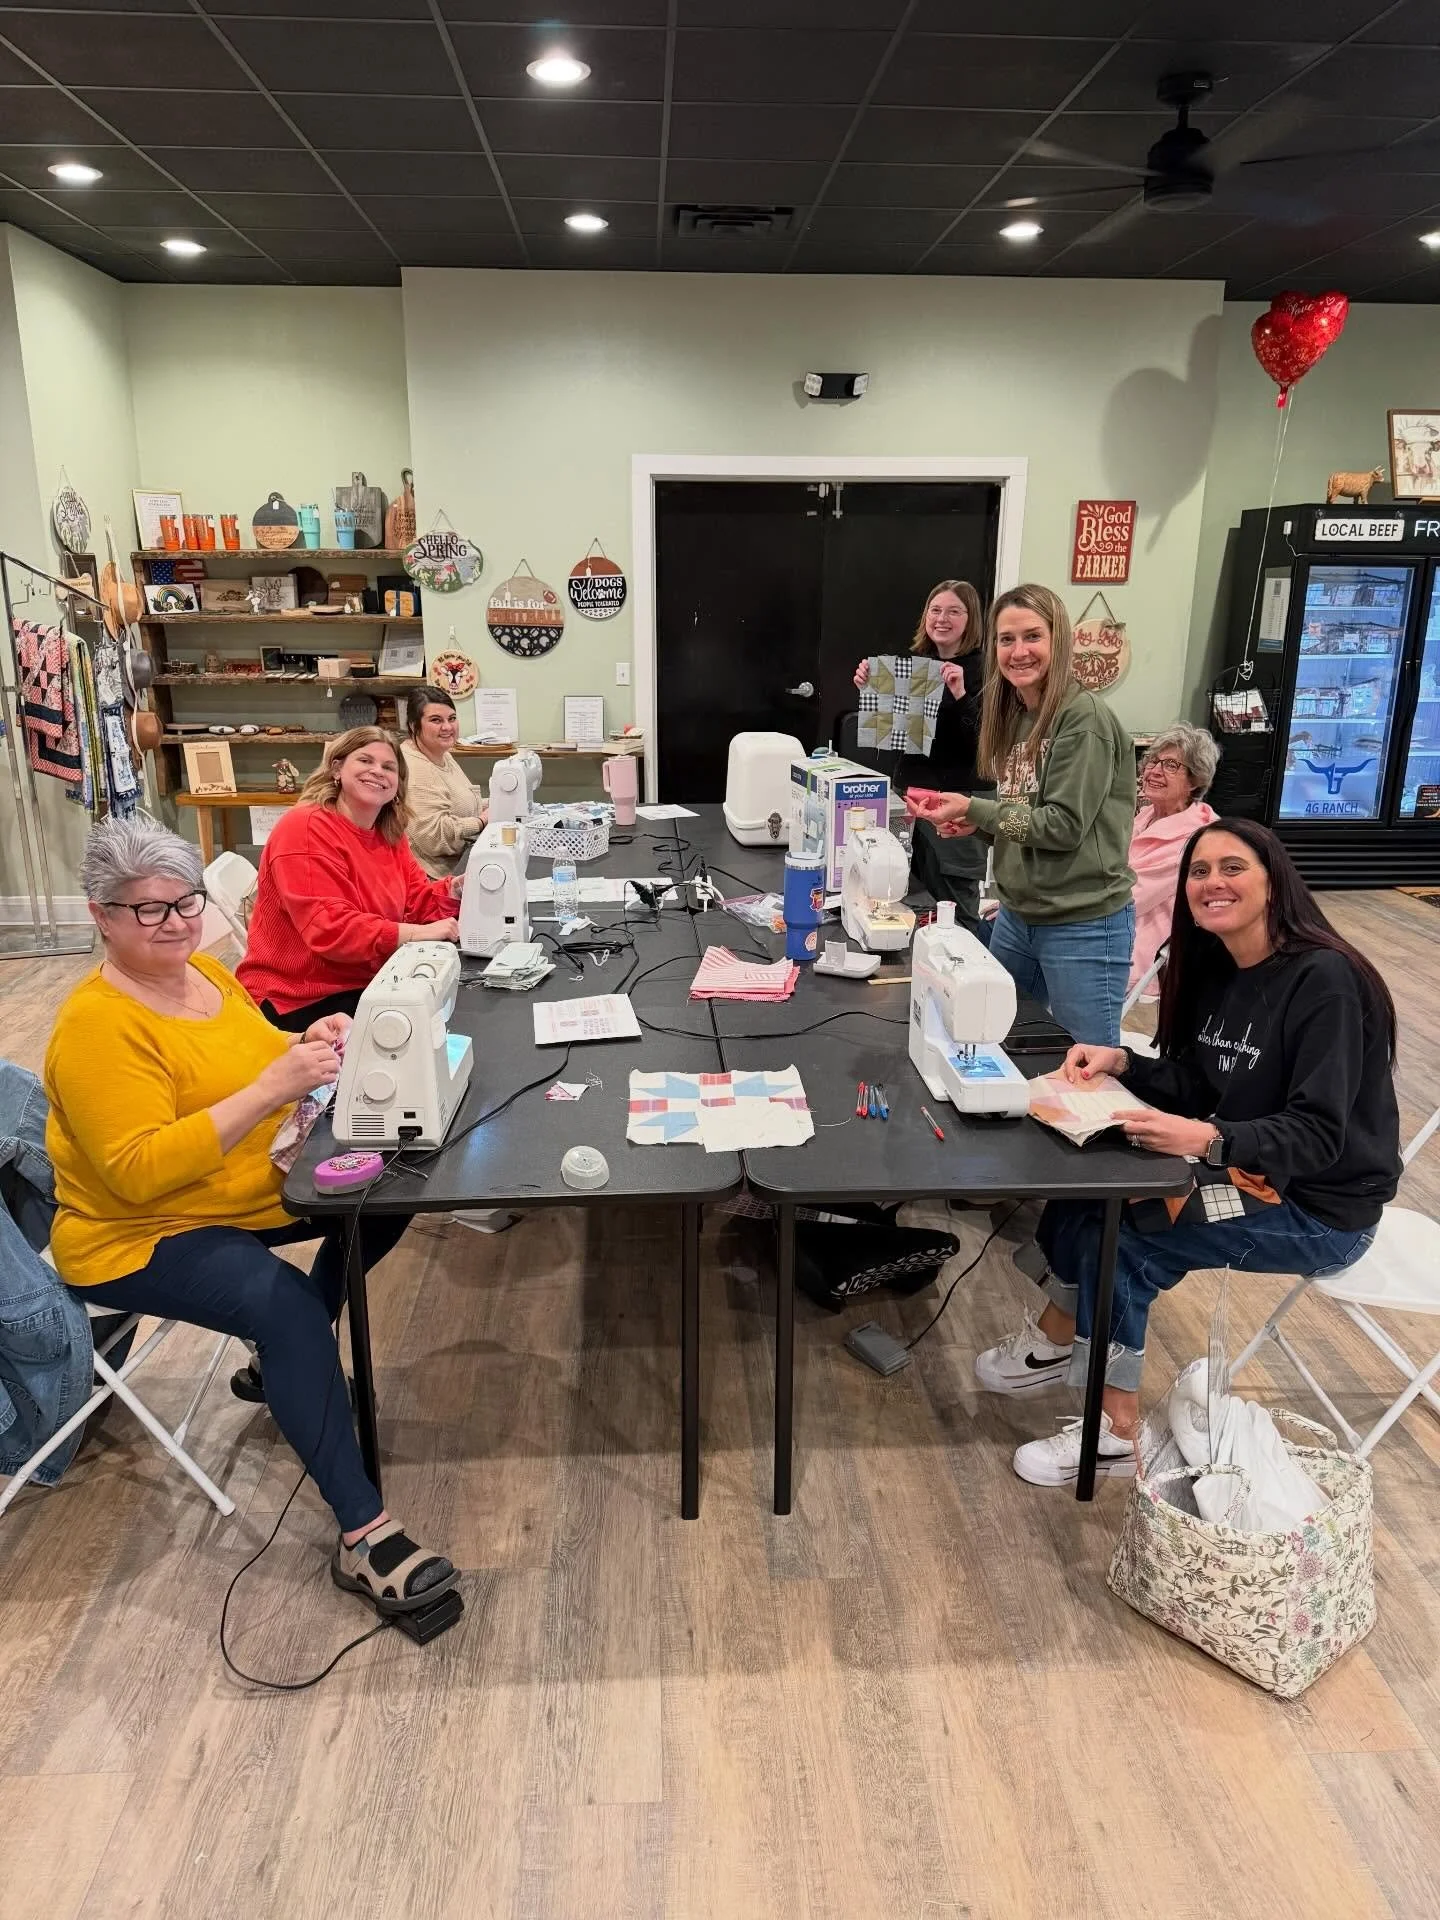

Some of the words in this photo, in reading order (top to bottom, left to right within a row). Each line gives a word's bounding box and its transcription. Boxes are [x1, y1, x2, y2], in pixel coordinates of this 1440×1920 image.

[1104, 505, 1132, 524] God
[1078, 516, 1130, 551] Bless
[1321, 523, 1364, 537] LOCAL
[1368, 523, 1399, 537] BEEF
[426, 535, 458, 545] HELLO
[1114, 543, 1127, 553] the
[1075, 554, 1126, 578] FARMER
[595, 577, 623, 587] DOGS
[513, 597, 524, 609] is
[527, 598, 544, 610] for
[842, 783, 880, 794] brother
[1305, 802, 1319, 814] 4G
[1322, 802, 1358, 814] RANCH
[1211, 1018, 1232, 1049] than
